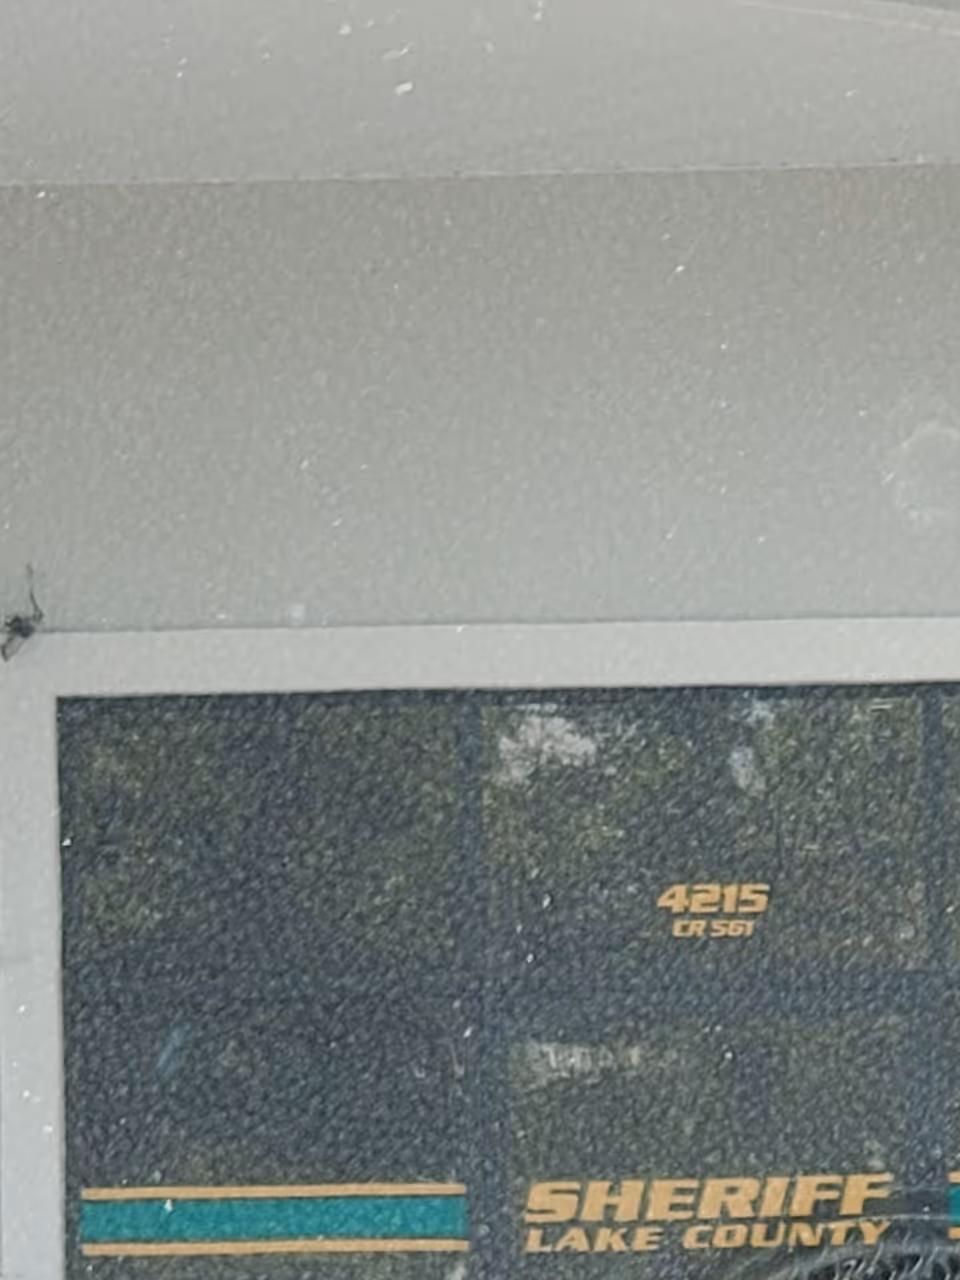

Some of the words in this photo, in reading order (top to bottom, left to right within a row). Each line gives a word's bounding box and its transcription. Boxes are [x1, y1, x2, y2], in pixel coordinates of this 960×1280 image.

[656, 883, 770, 913] 4215
[672, 920, 706, 937] CR
[710, 920, 755, 937] 561
[525, 1173, 894, 1223] SHERIFF
[525, 1226, 664, 1253] LAKE
[682, 1220, 891, 1250] COUNTY
